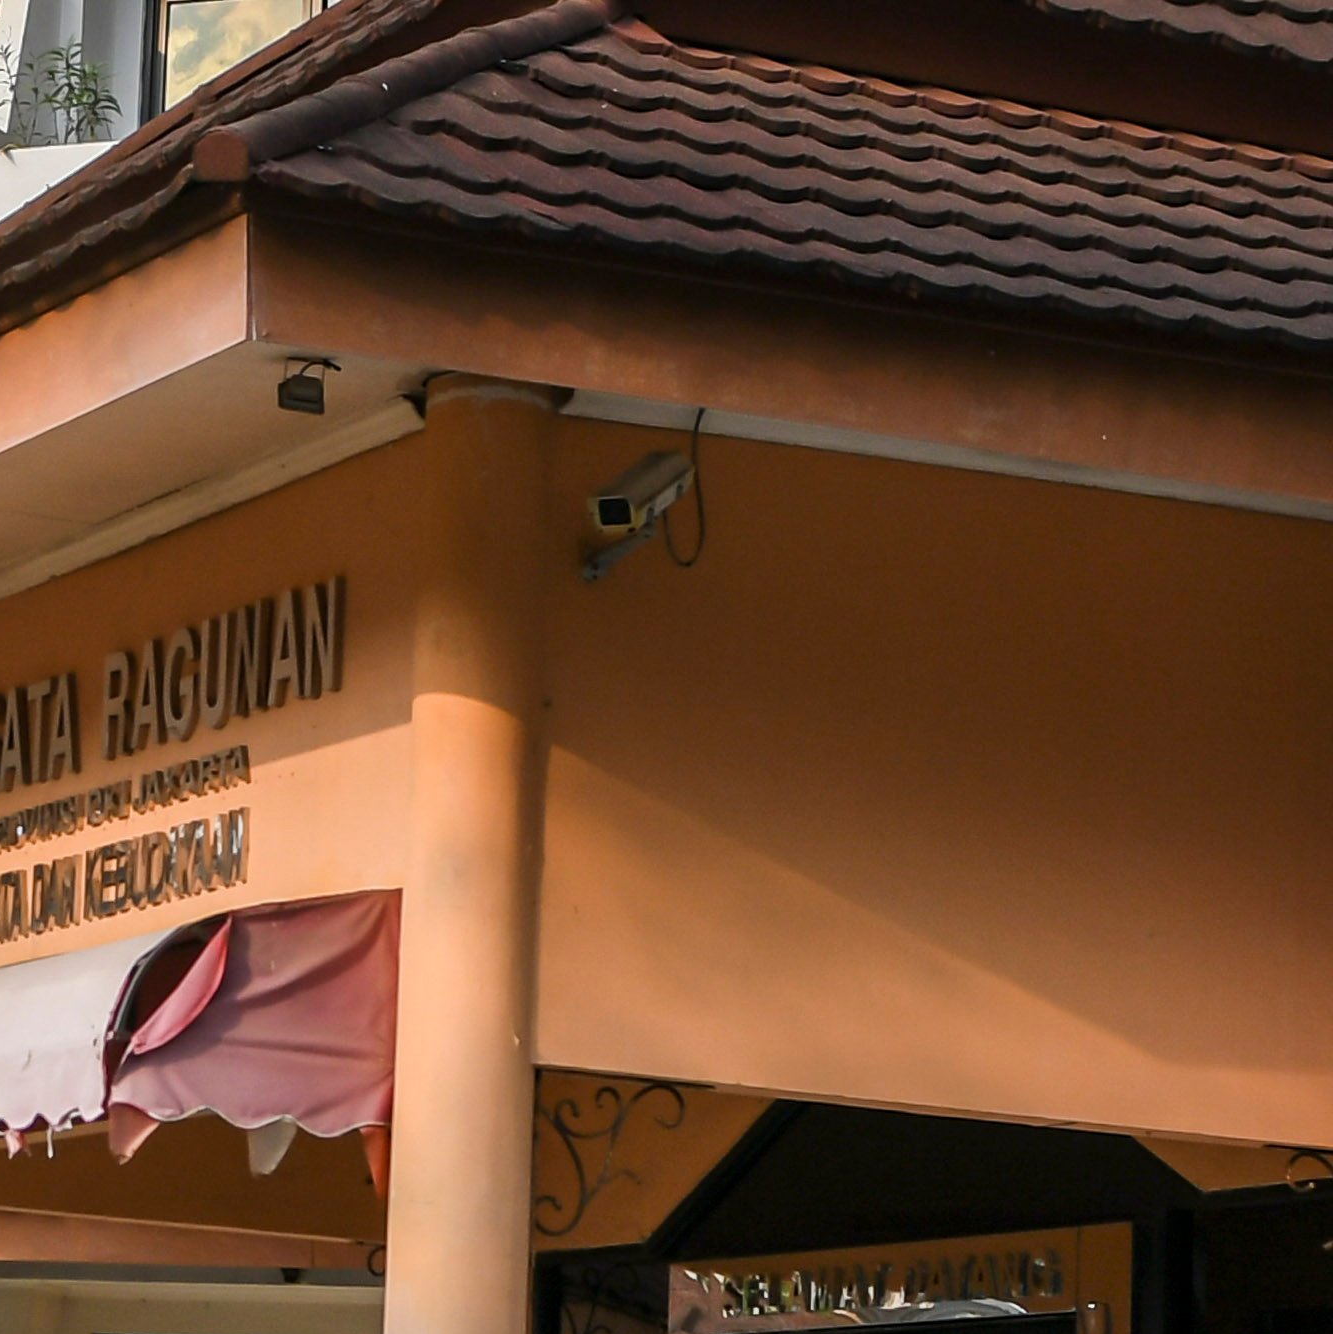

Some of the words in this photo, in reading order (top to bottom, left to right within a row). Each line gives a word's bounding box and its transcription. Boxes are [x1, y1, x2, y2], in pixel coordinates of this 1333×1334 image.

[103, 575, 345, 761] RAGUNAN
[132, 745, 250, 815] JAKARTA
[32, 854, 83, 934] DAN
